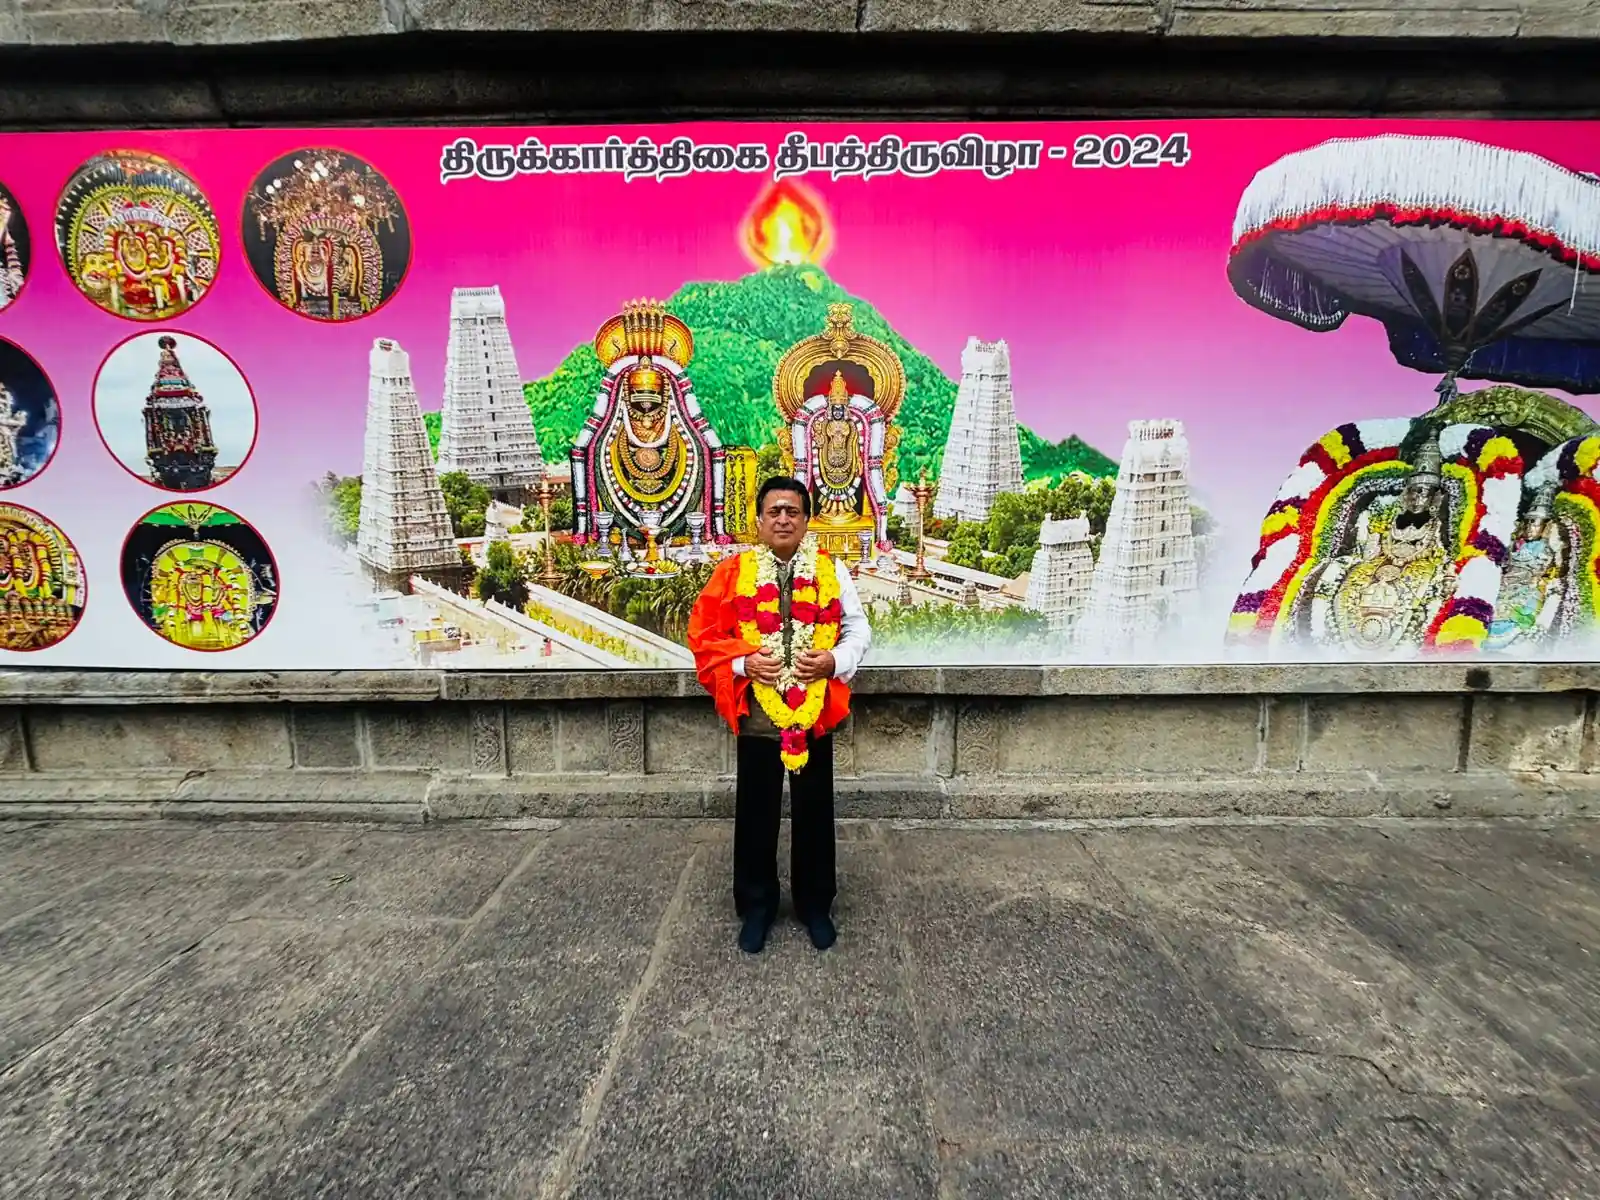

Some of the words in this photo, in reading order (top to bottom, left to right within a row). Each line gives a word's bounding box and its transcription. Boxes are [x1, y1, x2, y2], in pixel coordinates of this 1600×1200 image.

[442, 137, 768, 183] திருக்கார்த்திகை
[774, 132, 1042, 180] தீபத்திருவிழா
[1050, 147, 1065, 157] -
[1073, 134, 1190, 167] 2024
